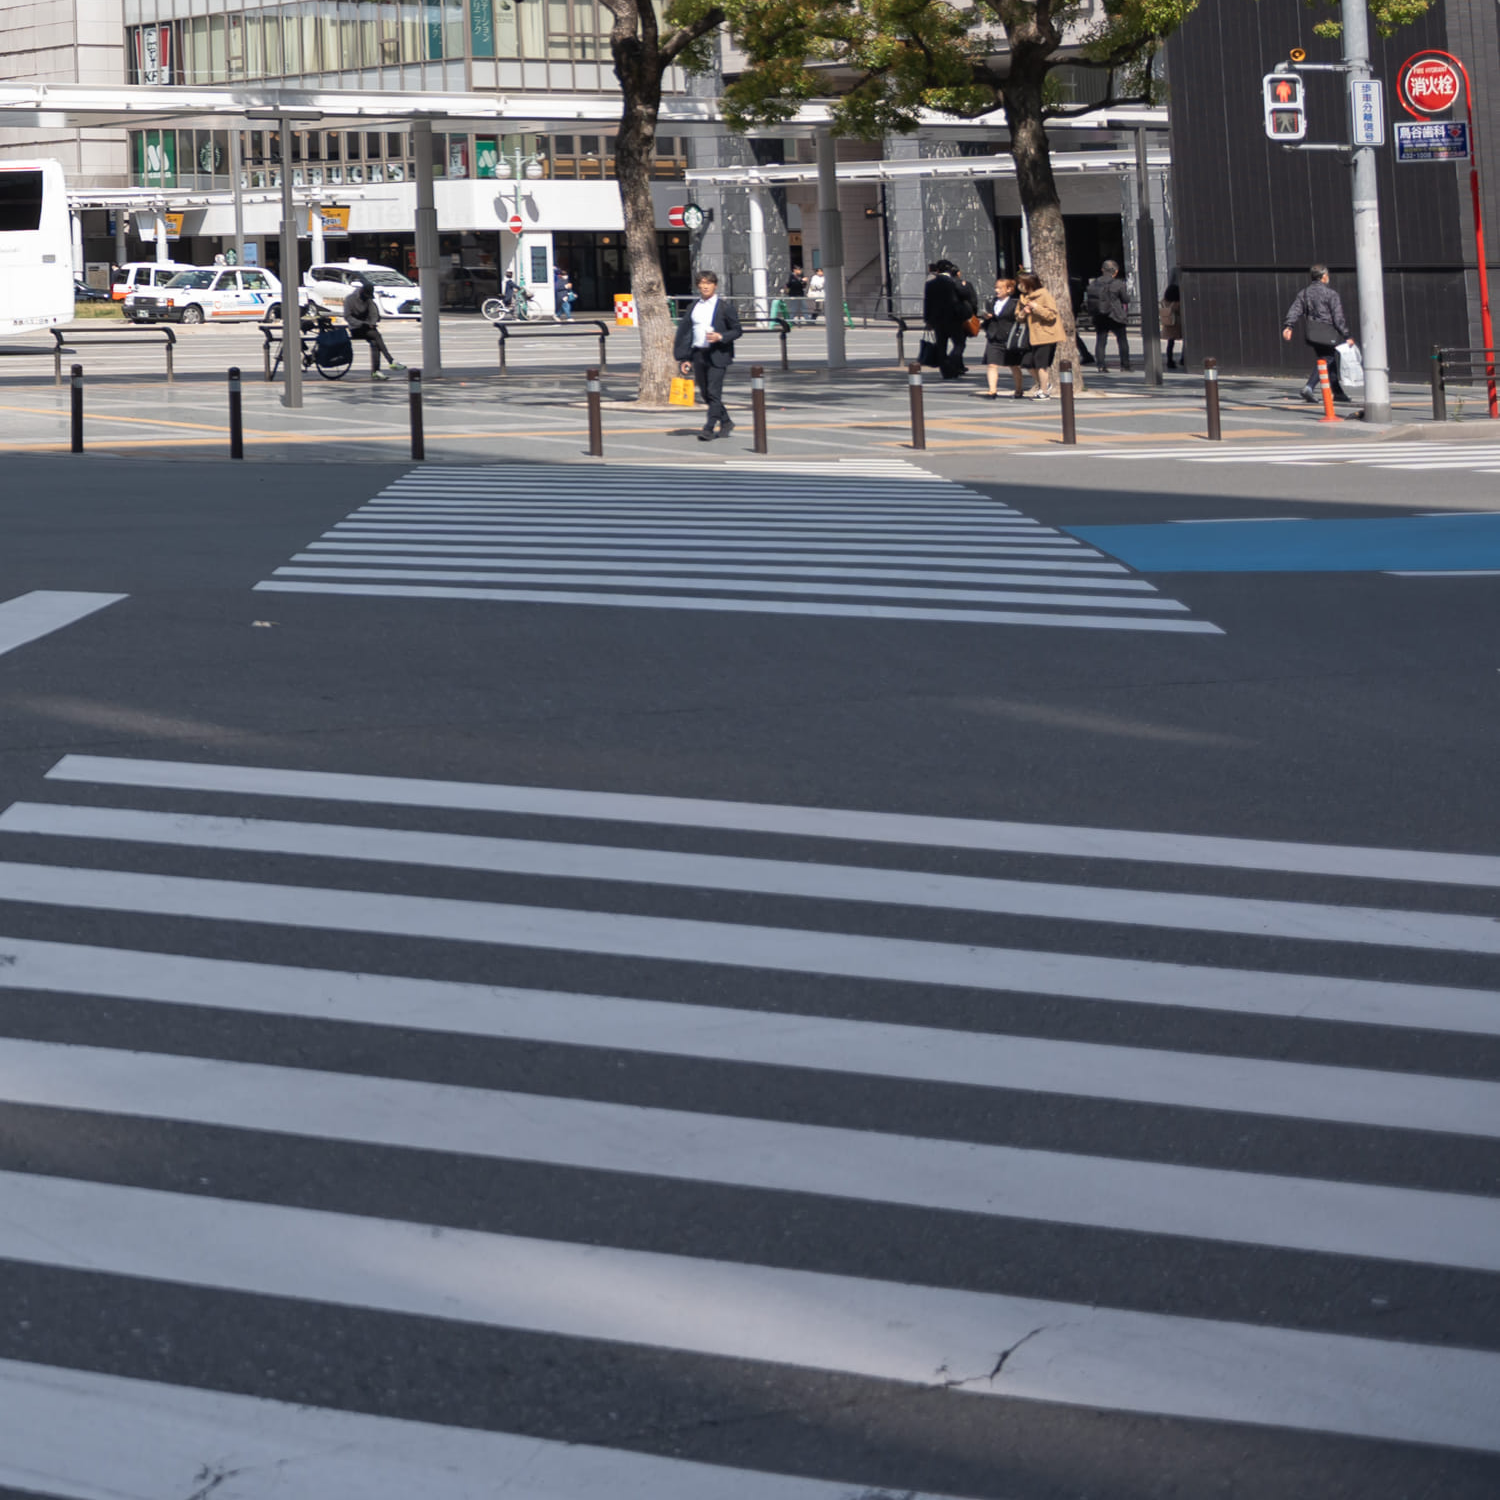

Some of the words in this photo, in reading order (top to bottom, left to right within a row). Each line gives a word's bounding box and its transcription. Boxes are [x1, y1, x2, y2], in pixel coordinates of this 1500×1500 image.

[1410, 75, 1454, 96] 消火栓
[1361, 83, 1374, 141] 歩車分離信号
